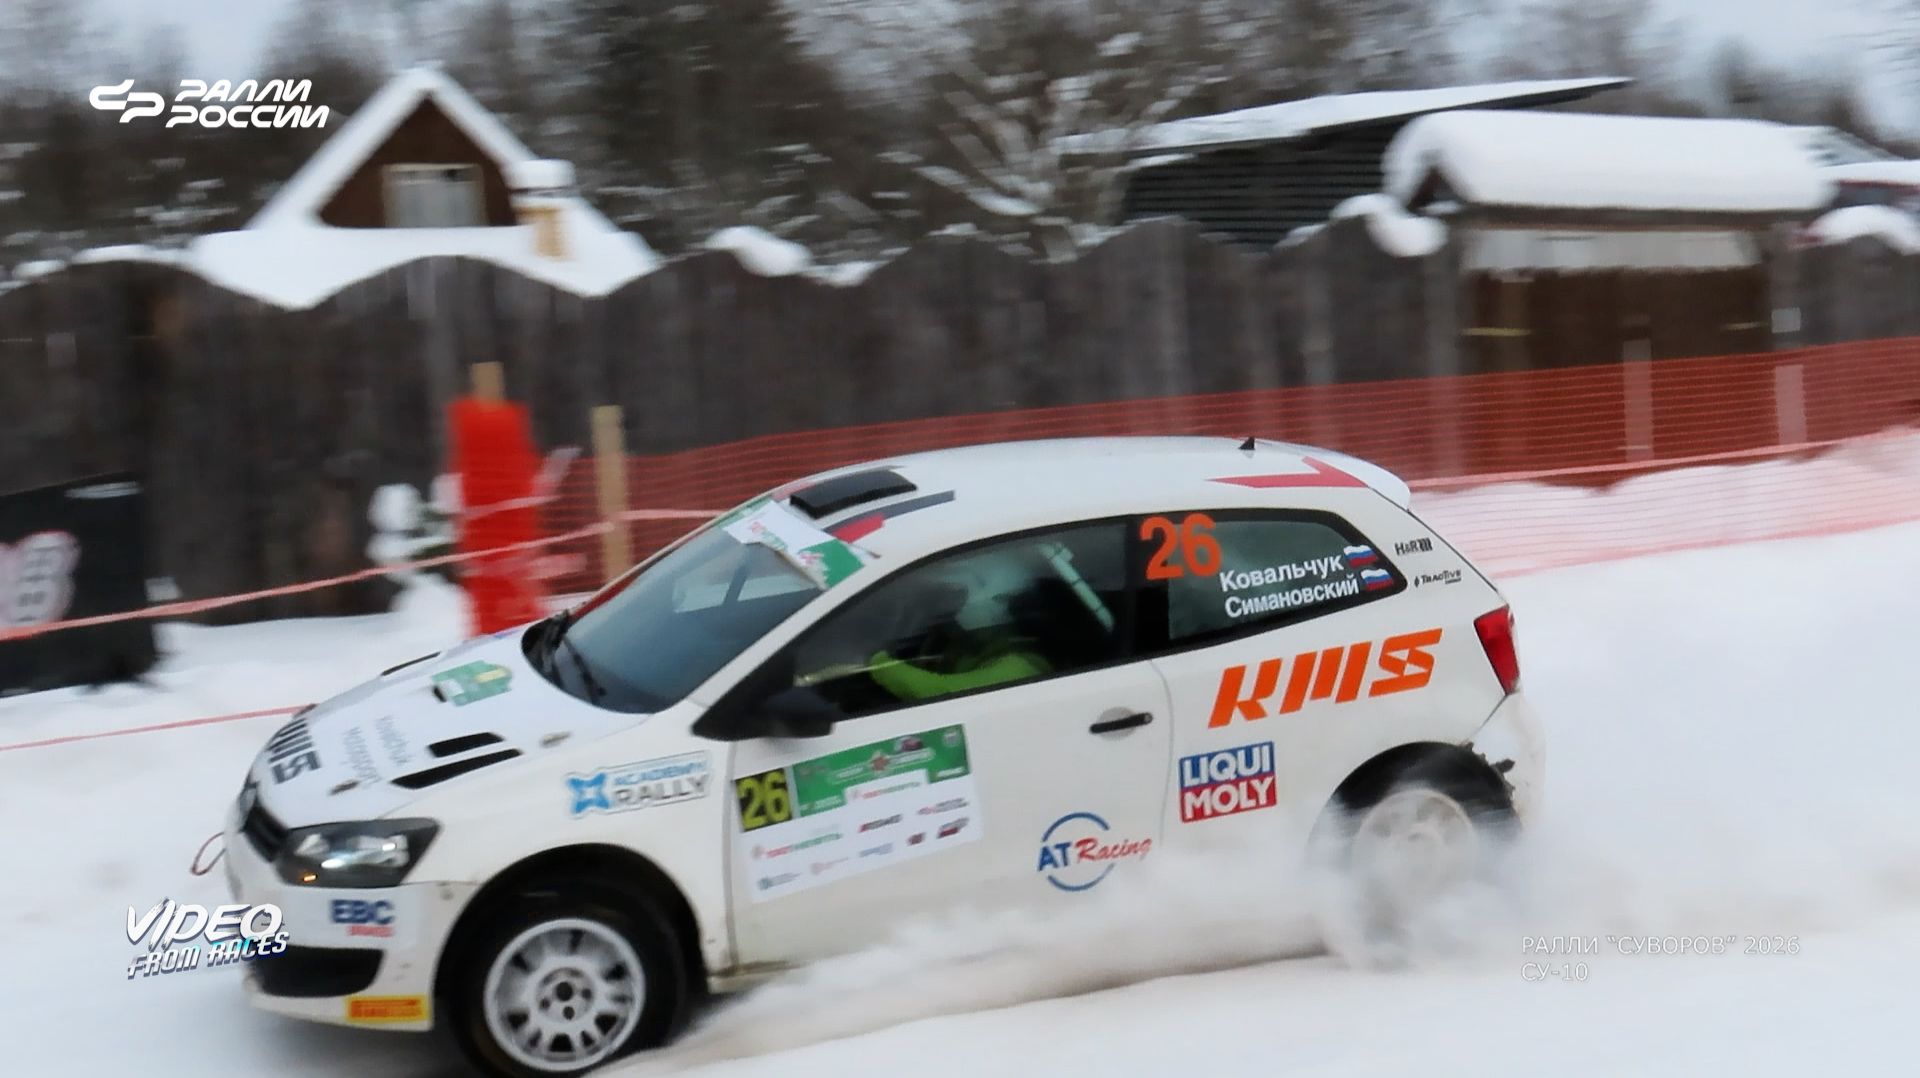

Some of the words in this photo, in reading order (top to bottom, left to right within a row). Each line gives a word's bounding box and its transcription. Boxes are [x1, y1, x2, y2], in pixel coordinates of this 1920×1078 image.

[1140, 513, 1221, 581] 26
[1220, 554, 1344, 593] Ковальчук
[1224, 574, 1360, 619] Симановский
[1208, 628, 1443, 728] KMS
[1182, 744, 1272, 788] LIQUI
[614, 773, 711, 804] RALLY
[736, 770, 793, 831] 26
[1184, 775, 1275, 820] MOLY
[1037, 842, 1073, 872] AT
[1074, 837, 1153, 865] Racing
[332, 900, 395, 924] EBC
